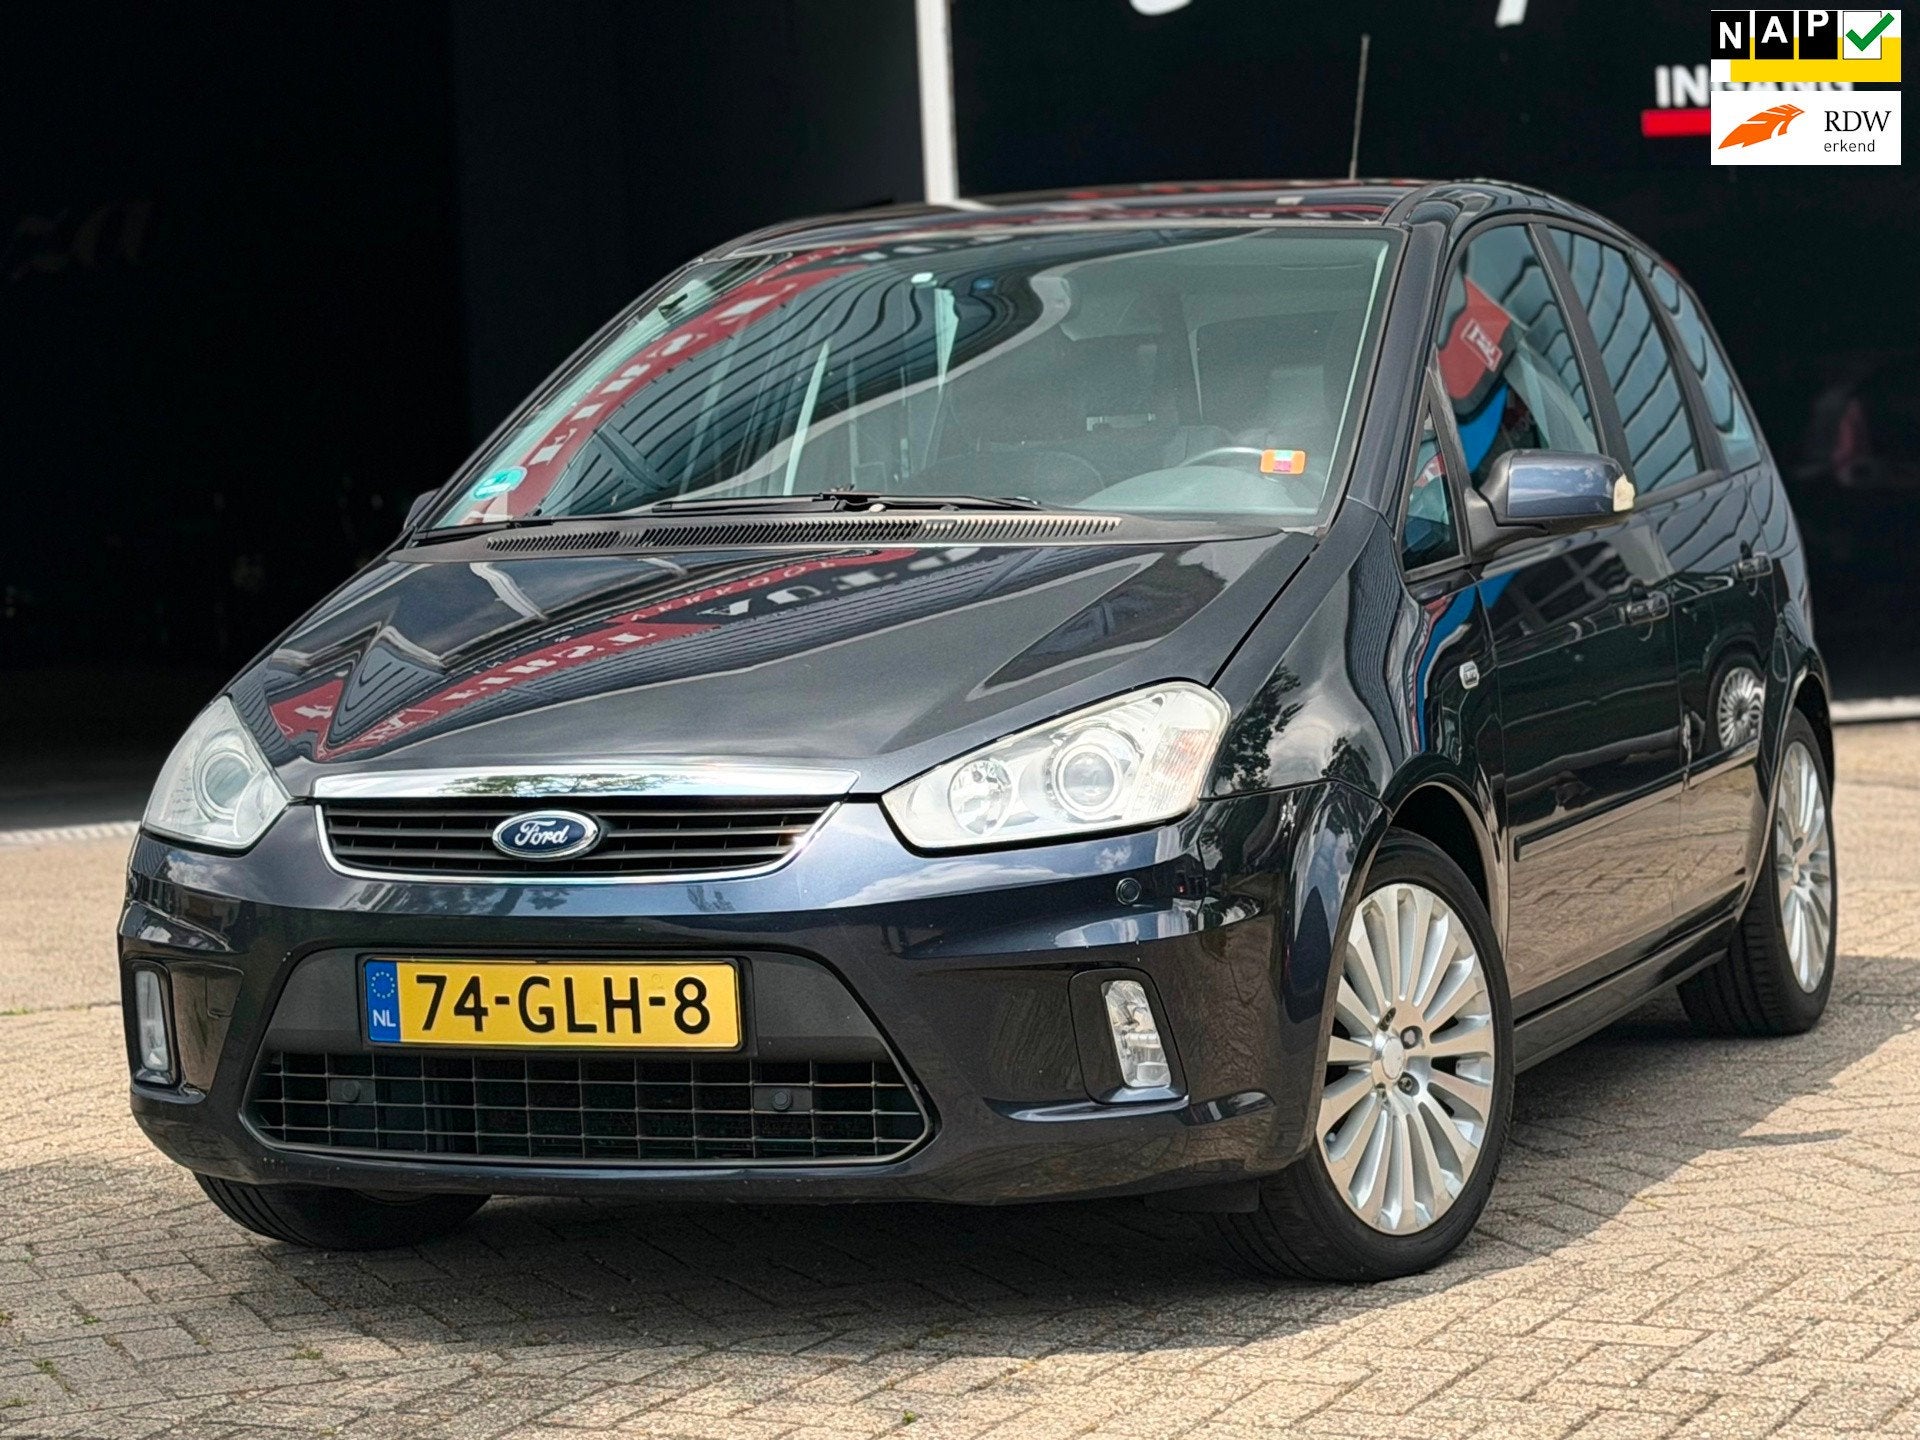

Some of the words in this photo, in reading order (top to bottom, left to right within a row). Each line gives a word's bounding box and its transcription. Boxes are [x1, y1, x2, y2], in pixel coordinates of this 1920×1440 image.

[514, 820, 570, 846] Ford
[415, 974, 711, 1035] 74-GLH-8
[372, 1009, 396, 1028] NL
